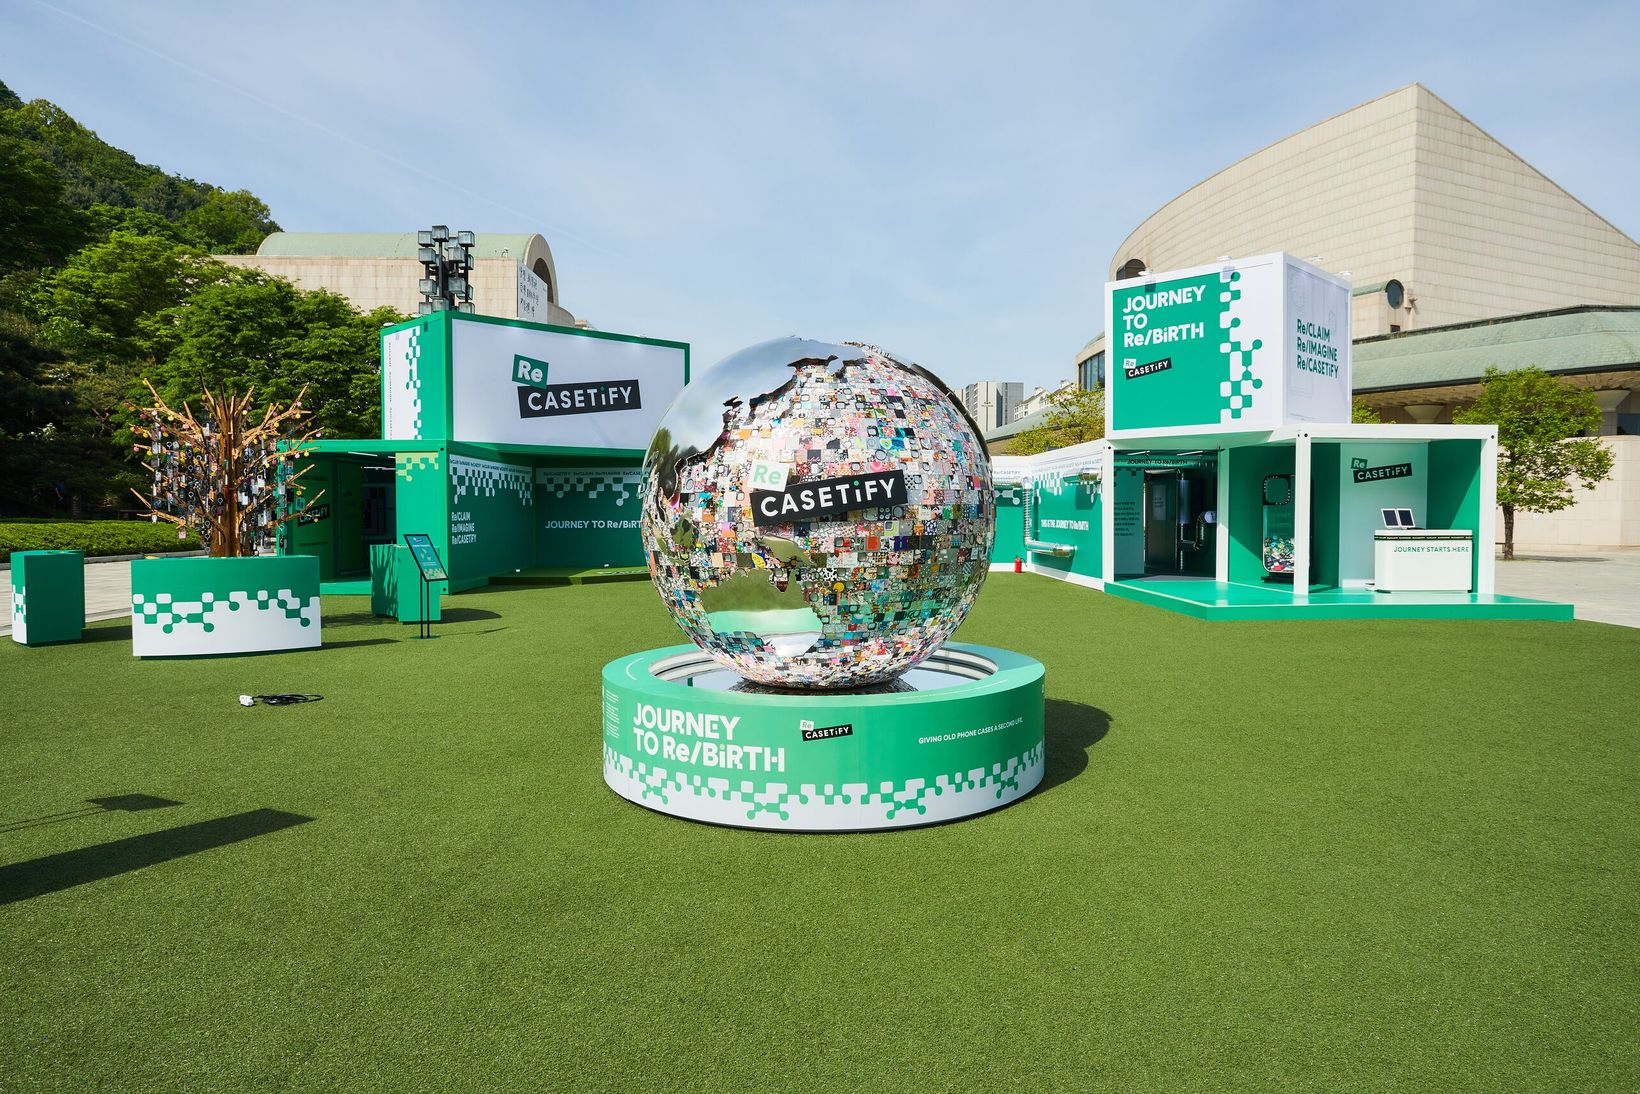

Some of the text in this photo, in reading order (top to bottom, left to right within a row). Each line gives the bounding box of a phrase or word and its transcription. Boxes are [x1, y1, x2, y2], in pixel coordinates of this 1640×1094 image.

[1123, 285, 1206, 313] JOURNEY
[1123, 313, 1148, 331] TO
[1297, 318, 1330, 342] Re/CLAIM
[1124, 322, 1204, 348] Re/BiRTH
[1297, 336, 1337, 361] Re/IMAGINE
[518, 359, 543, 383] Re
[1128, 360, 1169, 377] CASETiFY
[527, 386, 632, 411] CASETiFY
[753, 464, 782, 485] Re
[1353, 459, 1366, 468] Re
[1357, 466, 1408, 480] CASETiFY
[760, 478, 895, 517] CASETiFY
[545, 520, 642, 529] JOURNEY TO Re/BiRT
[633, 703, 741, 741] JOURNEY
[802, 721, 813, 729] Re
[805, 726, 850, 739] CASETiFY
[918, 735, 943, 744] GIVING
[943, 733, 957, 741] OLD
[957, 729, 977, 739] PHONE
[977, 725, 994, 735] CASES
[633, 727, 785, 773] TO Re/BiRTH
